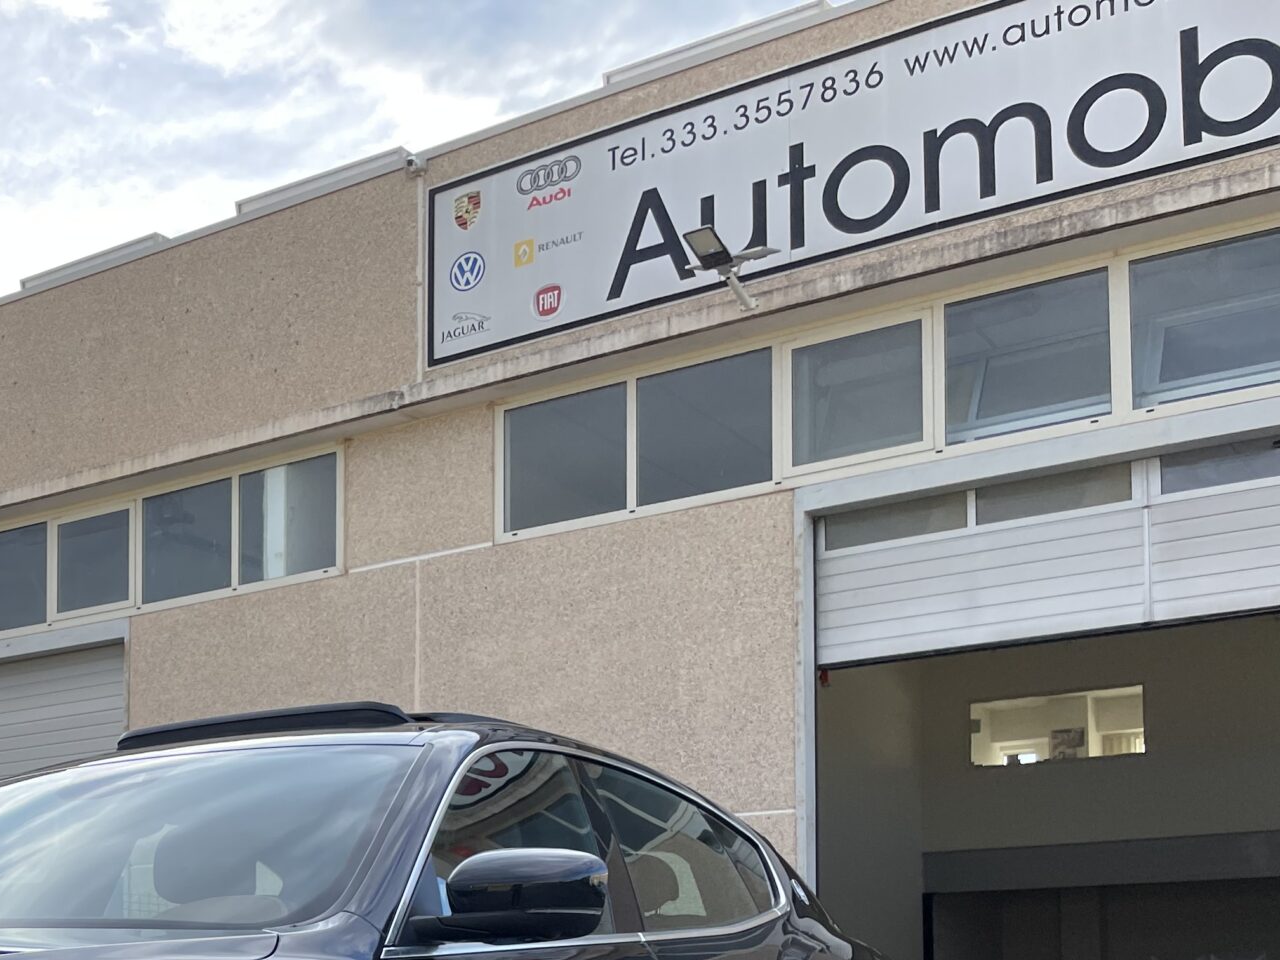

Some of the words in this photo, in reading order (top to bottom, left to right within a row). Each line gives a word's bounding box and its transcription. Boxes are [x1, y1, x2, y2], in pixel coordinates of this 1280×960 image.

[527, 187, 572, 211] Audi
[538, 231, 584, 253] RENAULT
[539, 289, 559, 312] FIAT
[440, 320, 485, 344] JAGUAR
